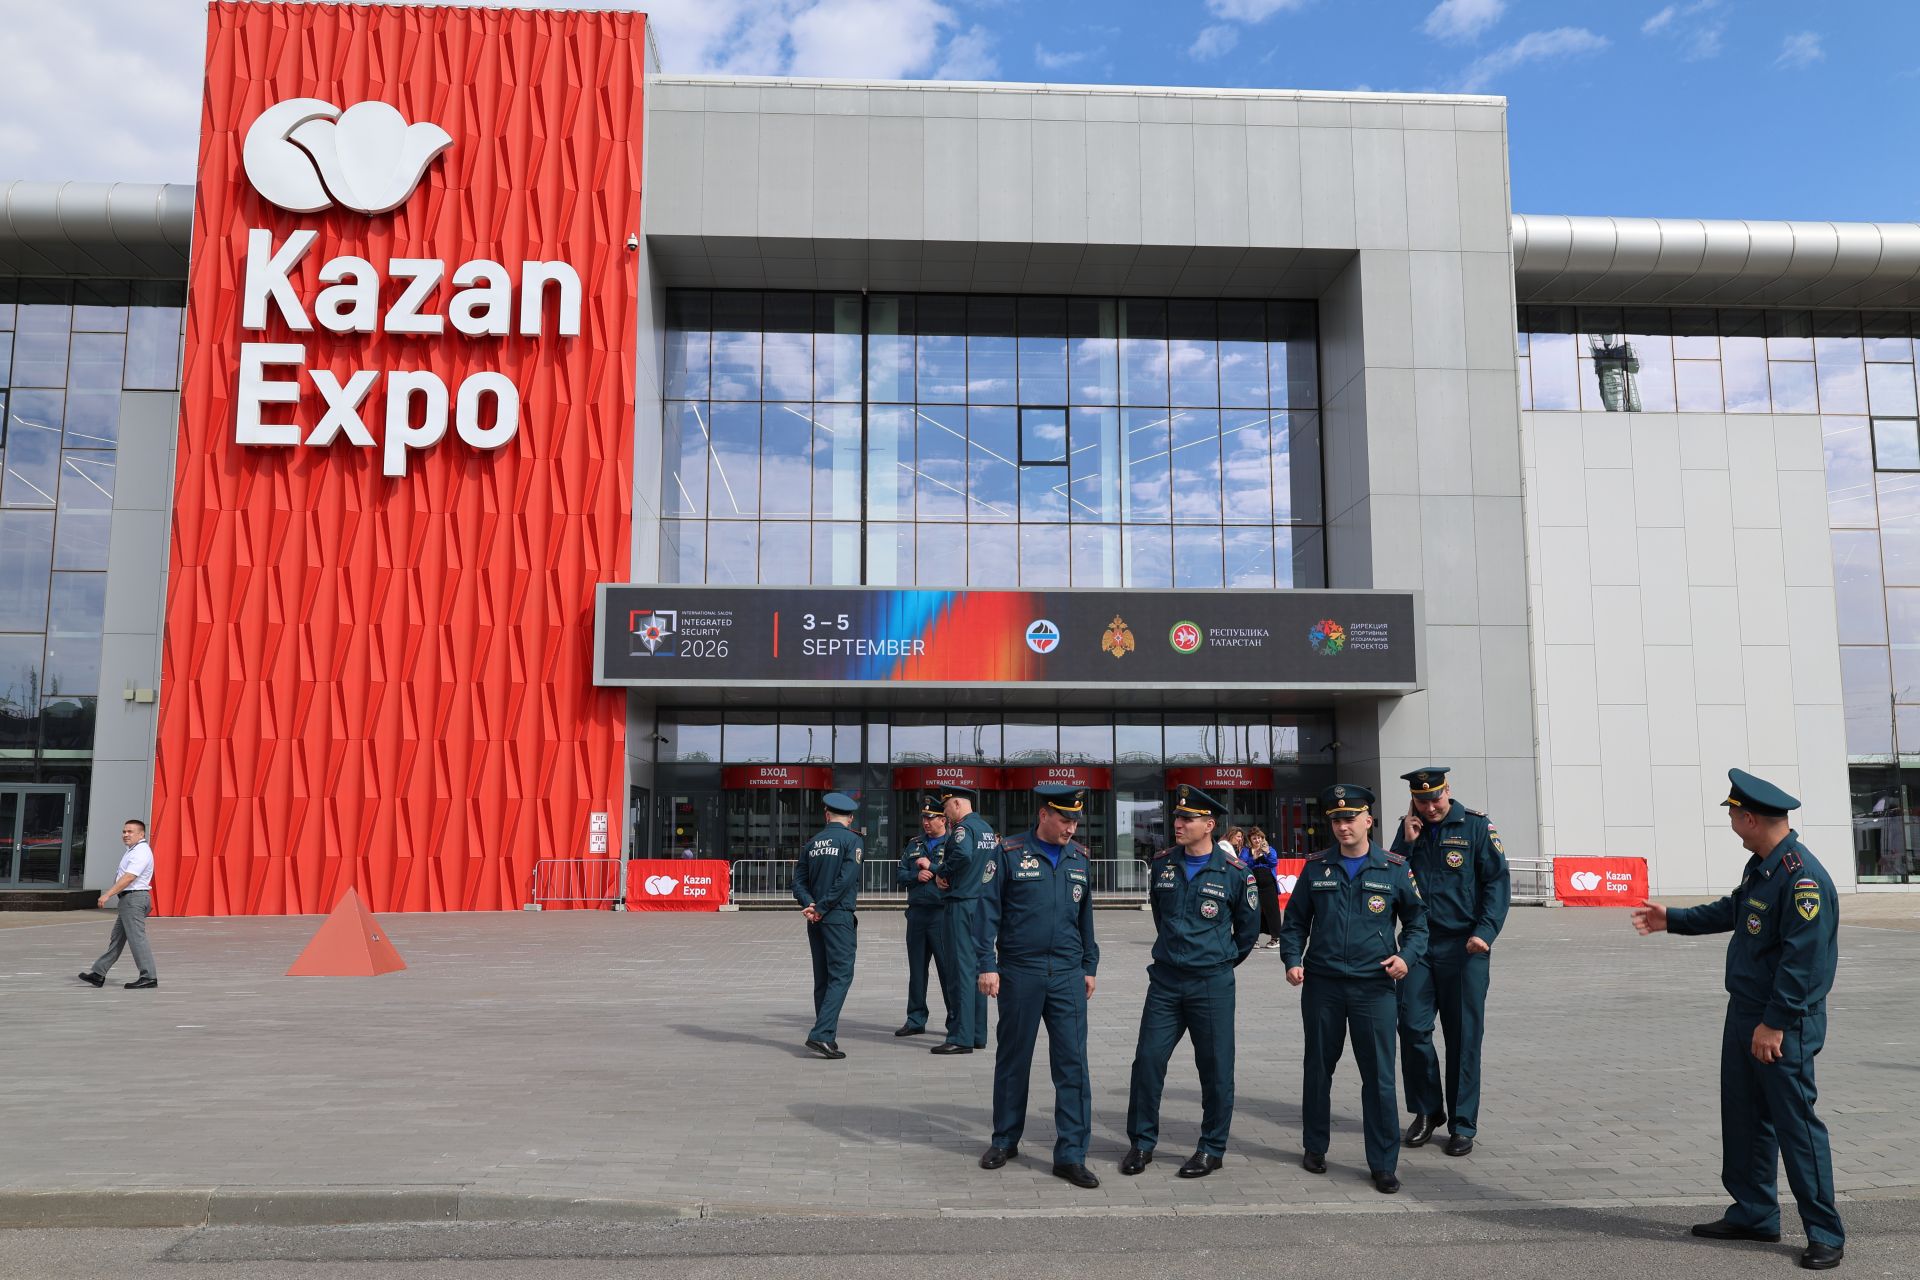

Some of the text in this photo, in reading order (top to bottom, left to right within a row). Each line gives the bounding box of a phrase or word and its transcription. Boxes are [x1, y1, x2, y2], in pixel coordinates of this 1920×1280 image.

[242, 228, 582, 338] Kazan
[235, 342, 520, 478] Expo
[681, 618, 733, 626] INTEGRATED
[1210, 628, 1270, 636] РЕСПУБЛИКА
[1210, 638, 1262, 646] ТАТАРСТАН
[680, 640, 729, 658] 2026
[802, 639, 925, 656] SEPTEMBER
[760, 768, 788, 778] ВХОД
[936, 768, 964, 778] ВХОД
[1048, 768, 1076, 778] ВХОД
[1216, 769, 1242, 778] ВХОД
[814, 839, 832, 848] МЧС
[683, 875, 712, 884] Kazan
[1606, 871, 1632, 880] Kazan
[683, 886, 706, 898] Expo
[1606, 882, 1628, 893] Expo
